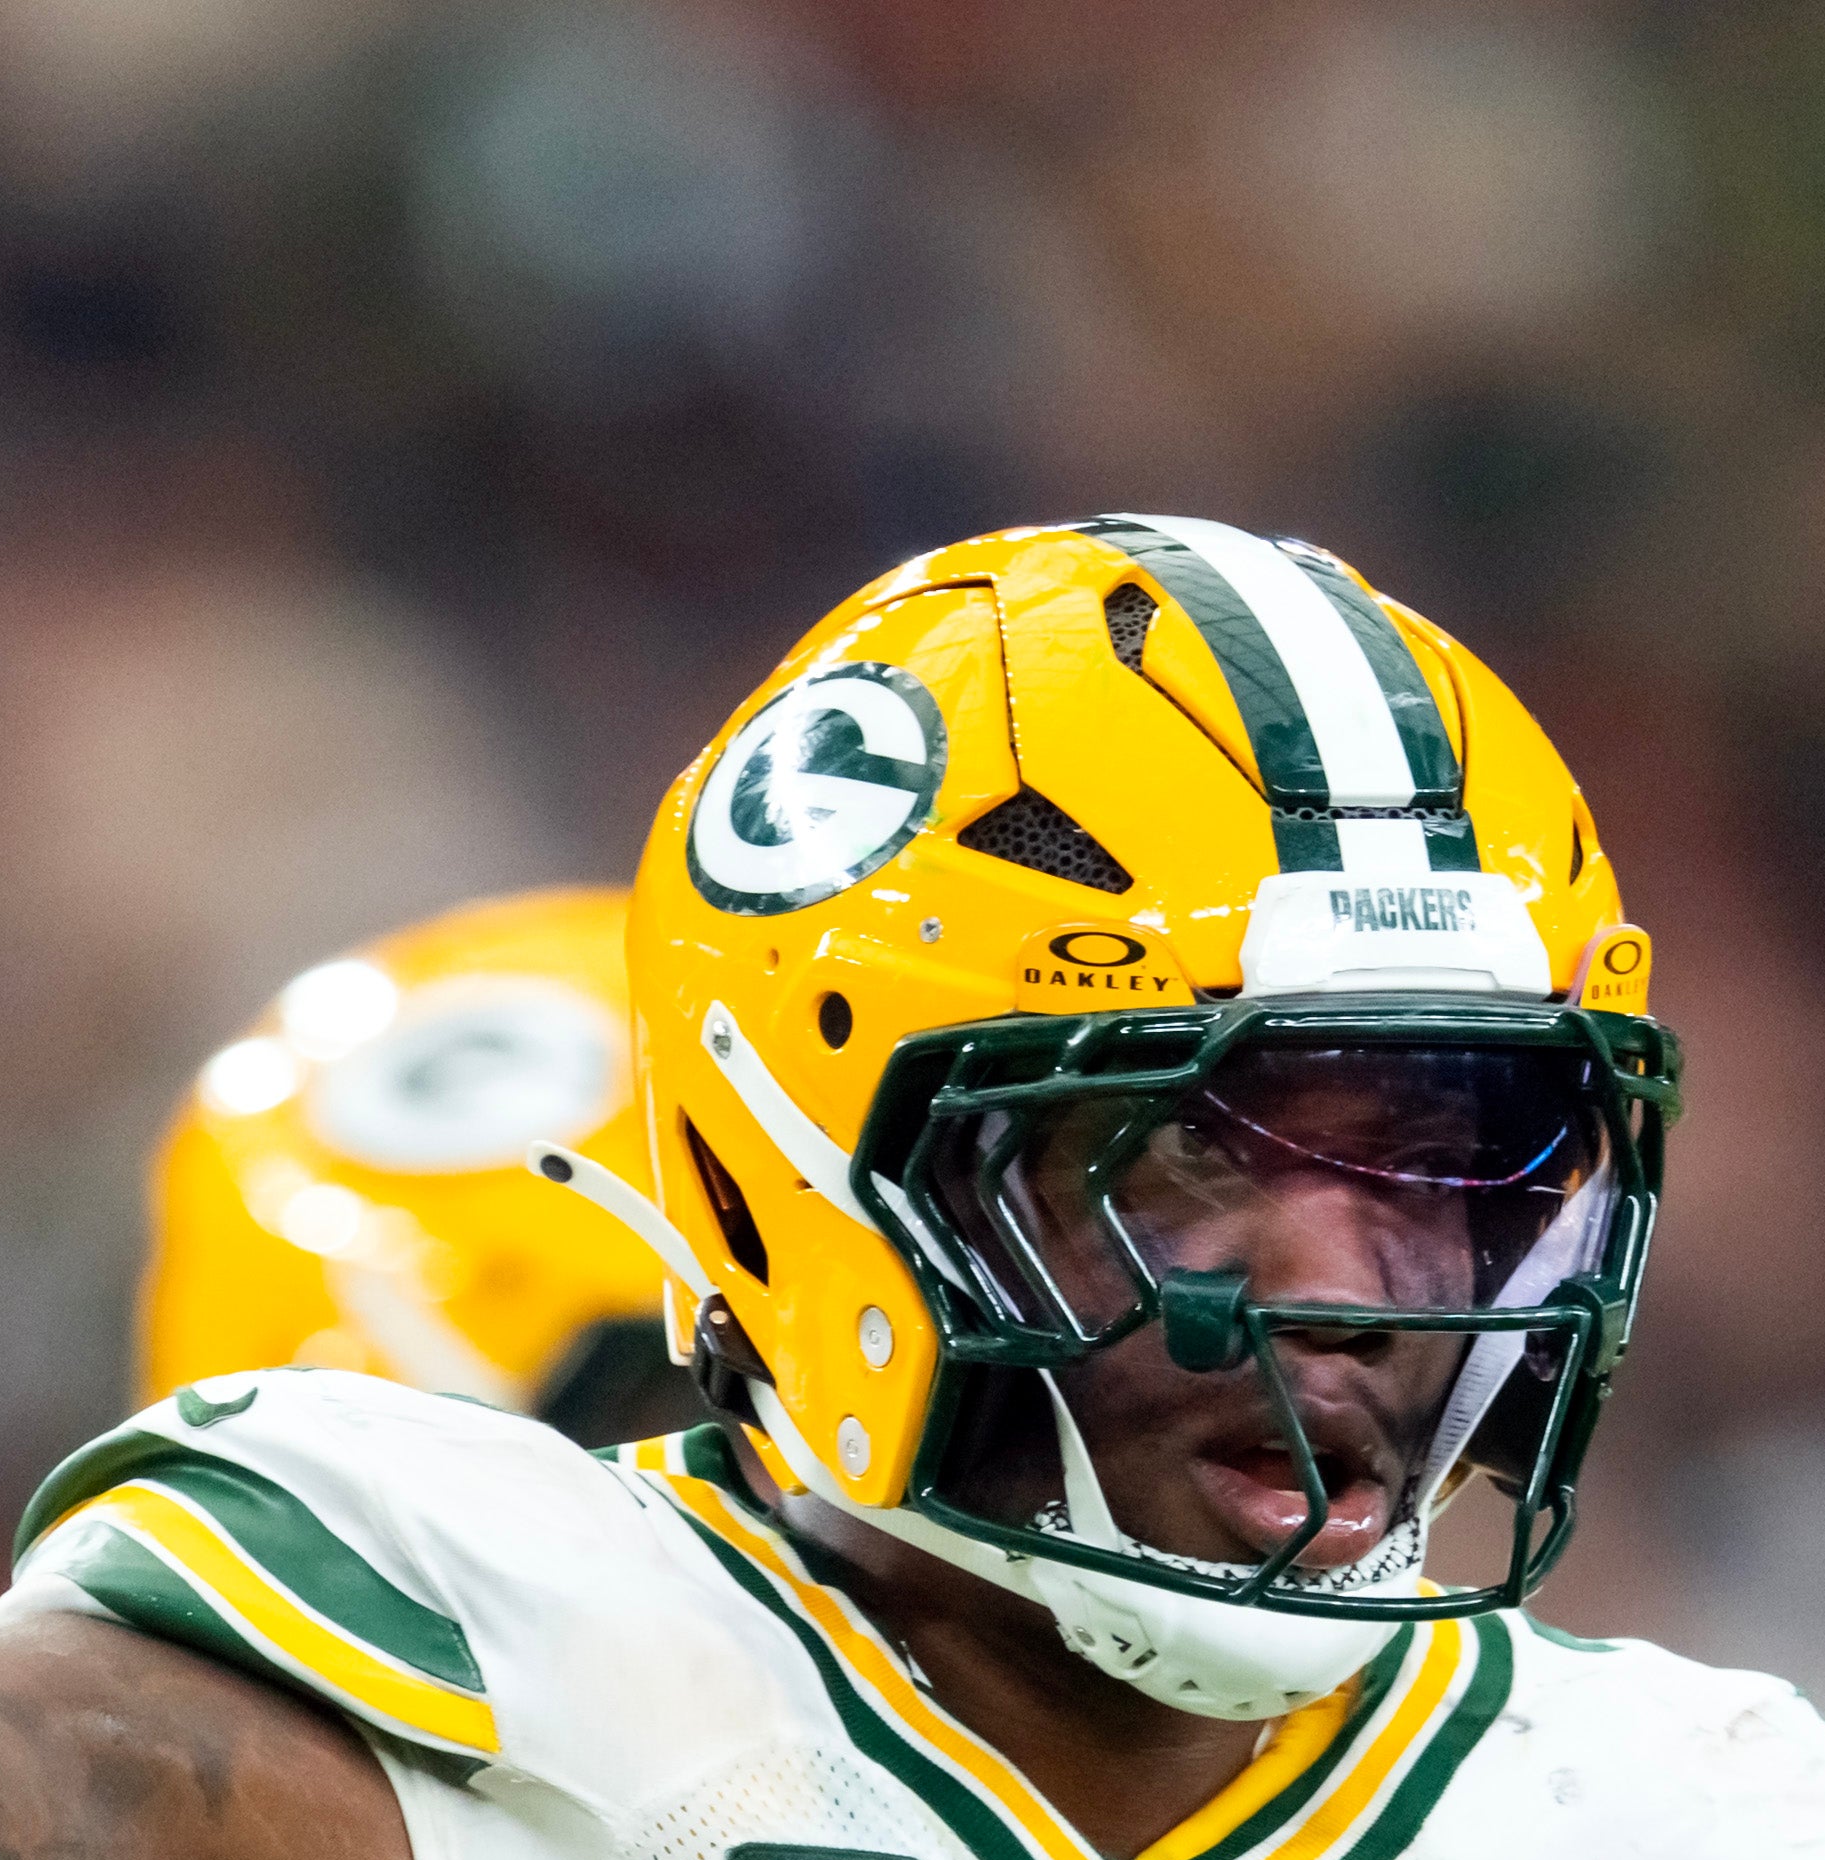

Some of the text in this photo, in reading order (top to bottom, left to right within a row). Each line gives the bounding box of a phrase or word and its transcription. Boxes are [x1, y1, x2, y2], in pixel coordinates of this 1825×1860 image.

[692, 677, 927, 895] G
[1328, 887, 1476, 933] PACKERS
[1024, 967, 1169, 992] OAKLEY
